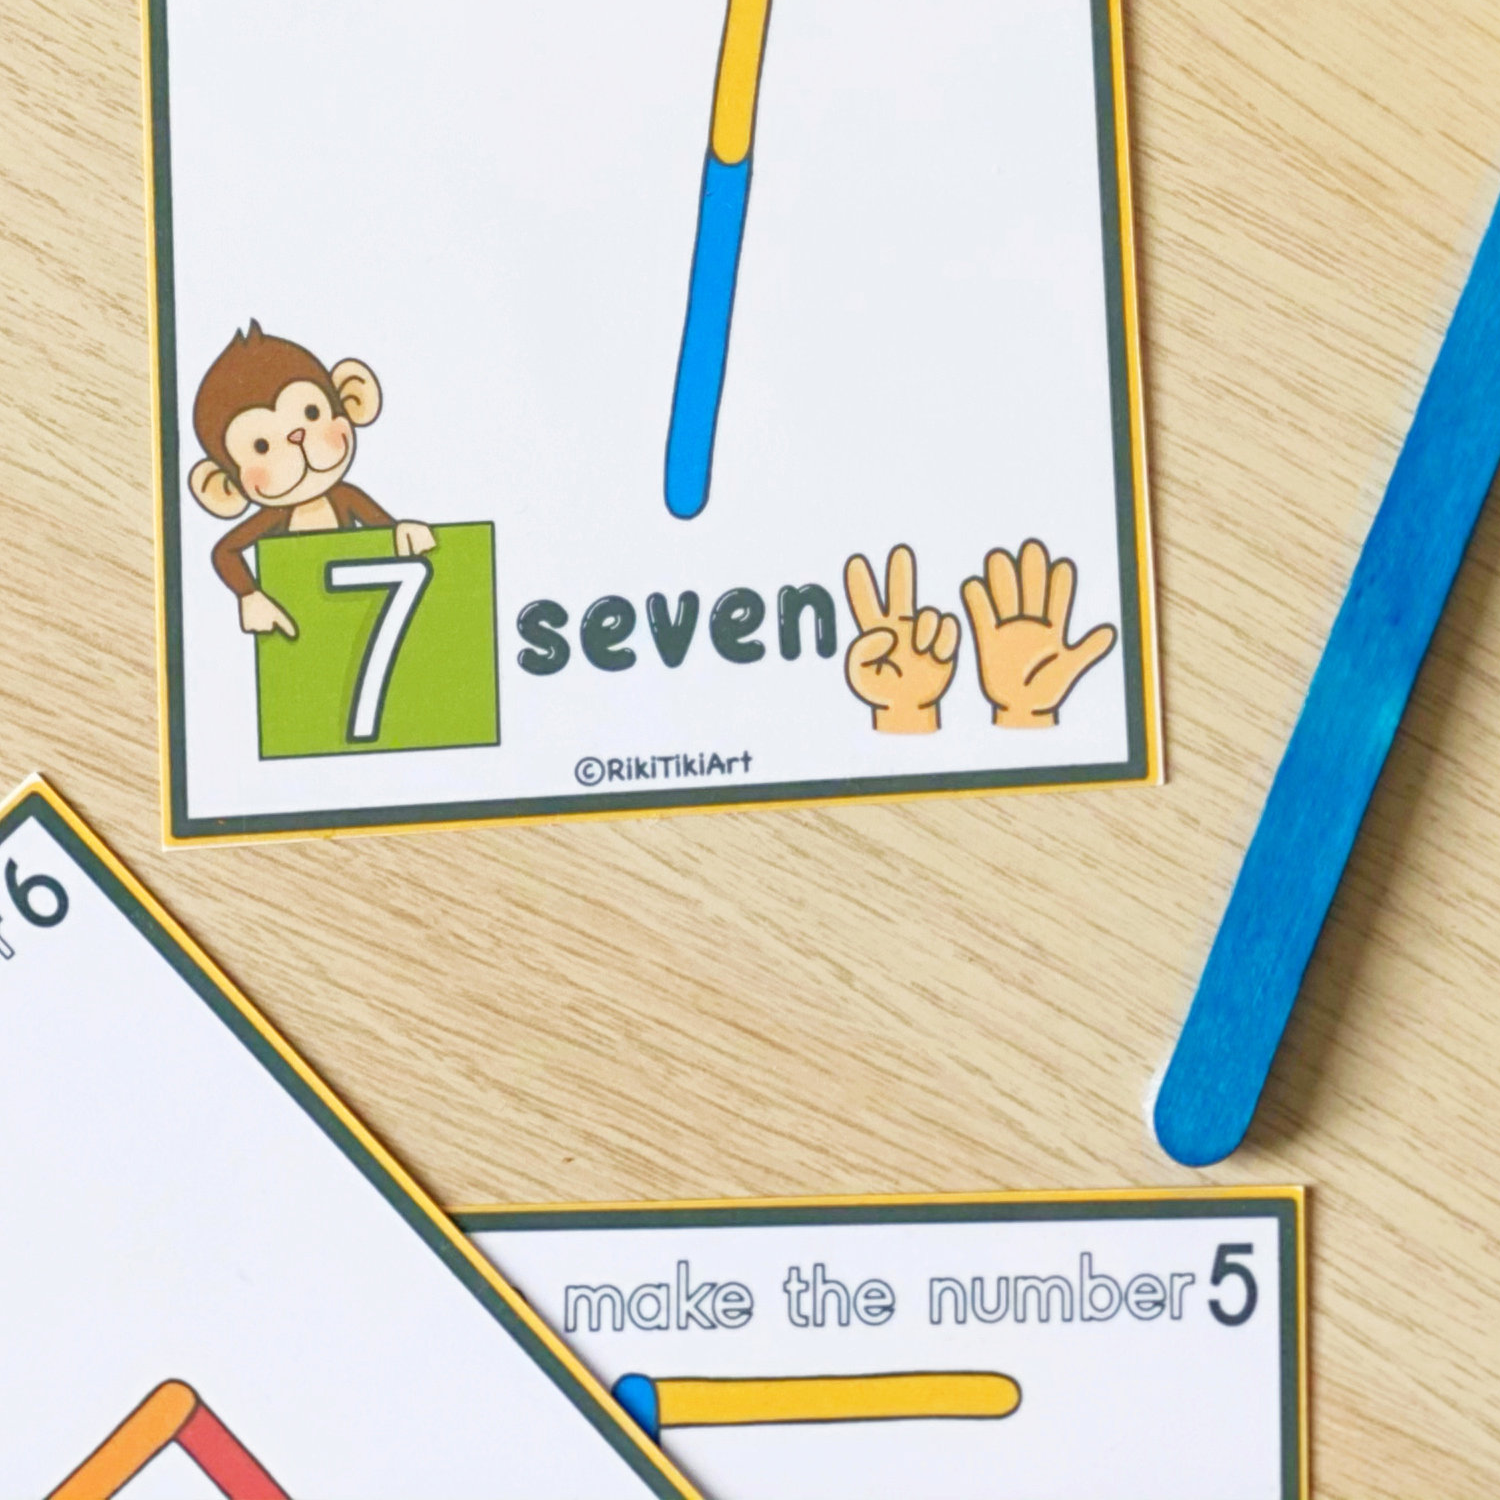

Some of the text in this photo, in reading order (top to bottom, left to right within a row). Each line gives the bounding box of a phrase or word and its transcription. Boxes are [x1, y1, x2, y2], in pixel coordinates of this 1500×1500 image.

[323, 555, 435, 745] 7
[516, 583, 838, 676] seven
[4, 856, 70, 929] 6
[564, 1260, 755, 1333] make
[783, 1263, 897, 1328] the
